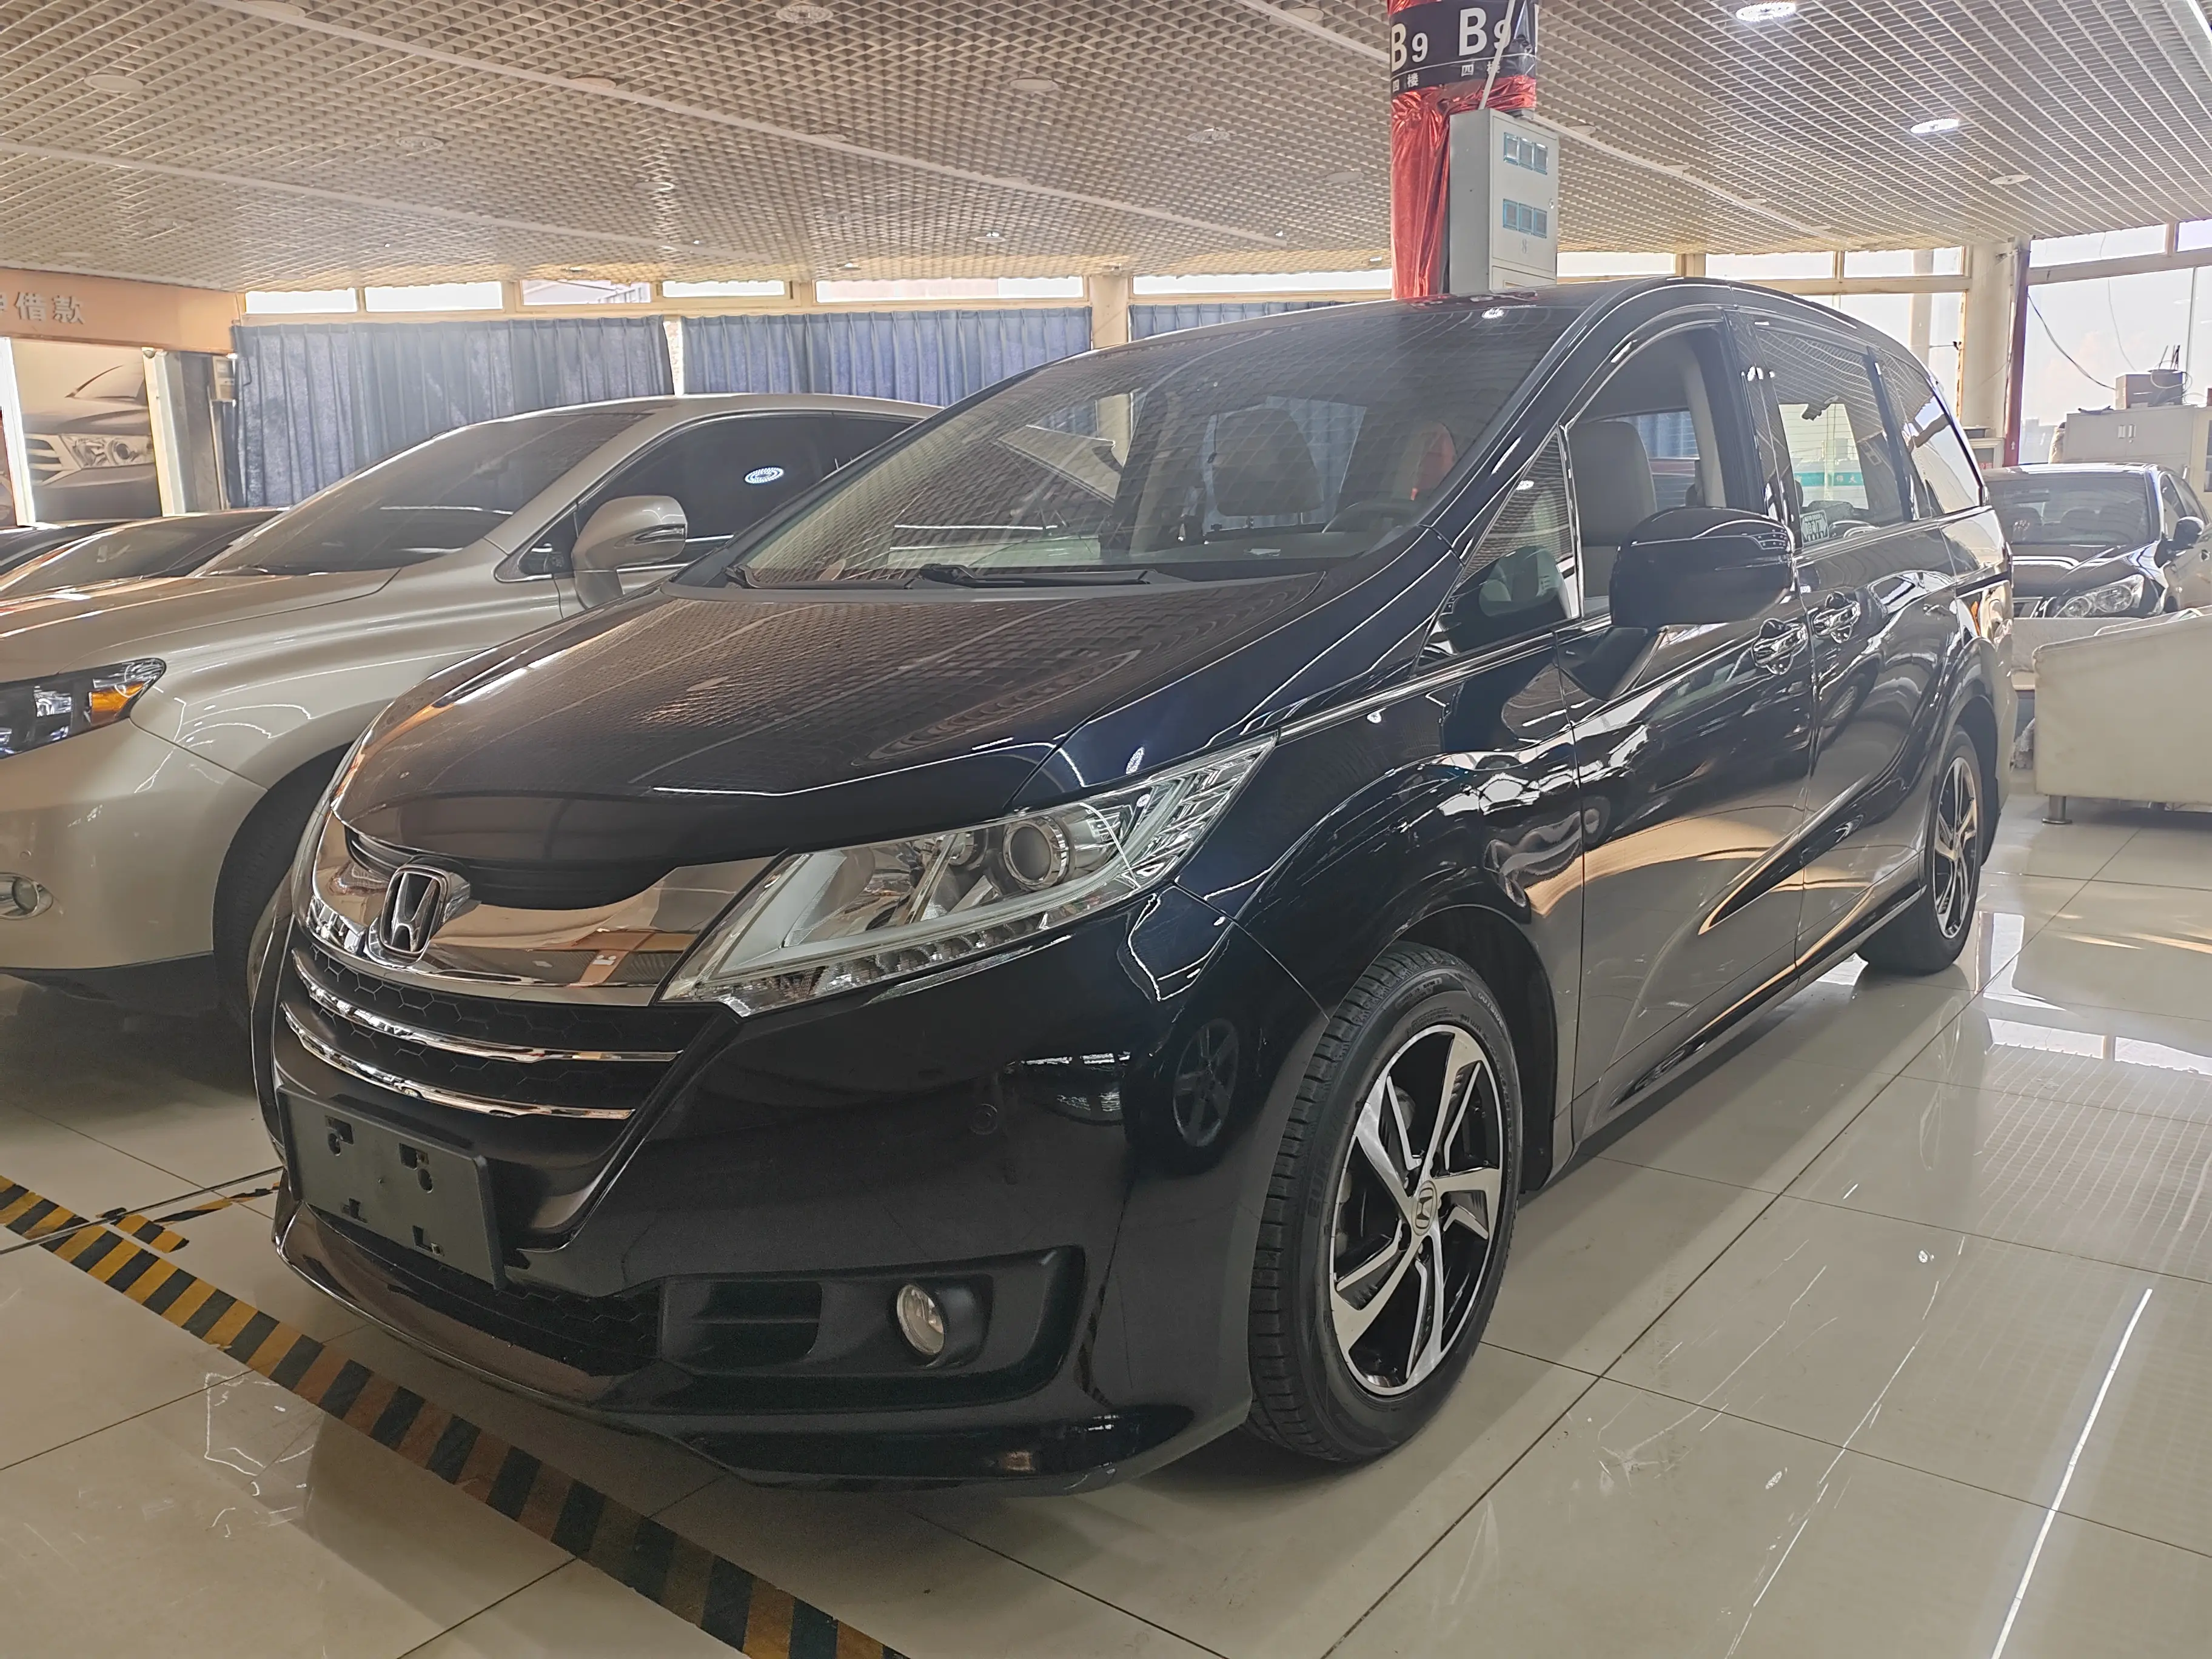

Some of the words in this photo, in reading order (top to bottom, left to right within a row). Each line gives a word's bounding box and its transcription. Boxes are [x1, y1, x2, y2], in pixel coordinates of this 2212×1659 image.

[1392, 23, 1428, 72] B9
[1459, 7, 1511, 56] B9
[0, 292, 85, 325] 借款
[1478, 992, 1504, 1028] OUTSIDE
